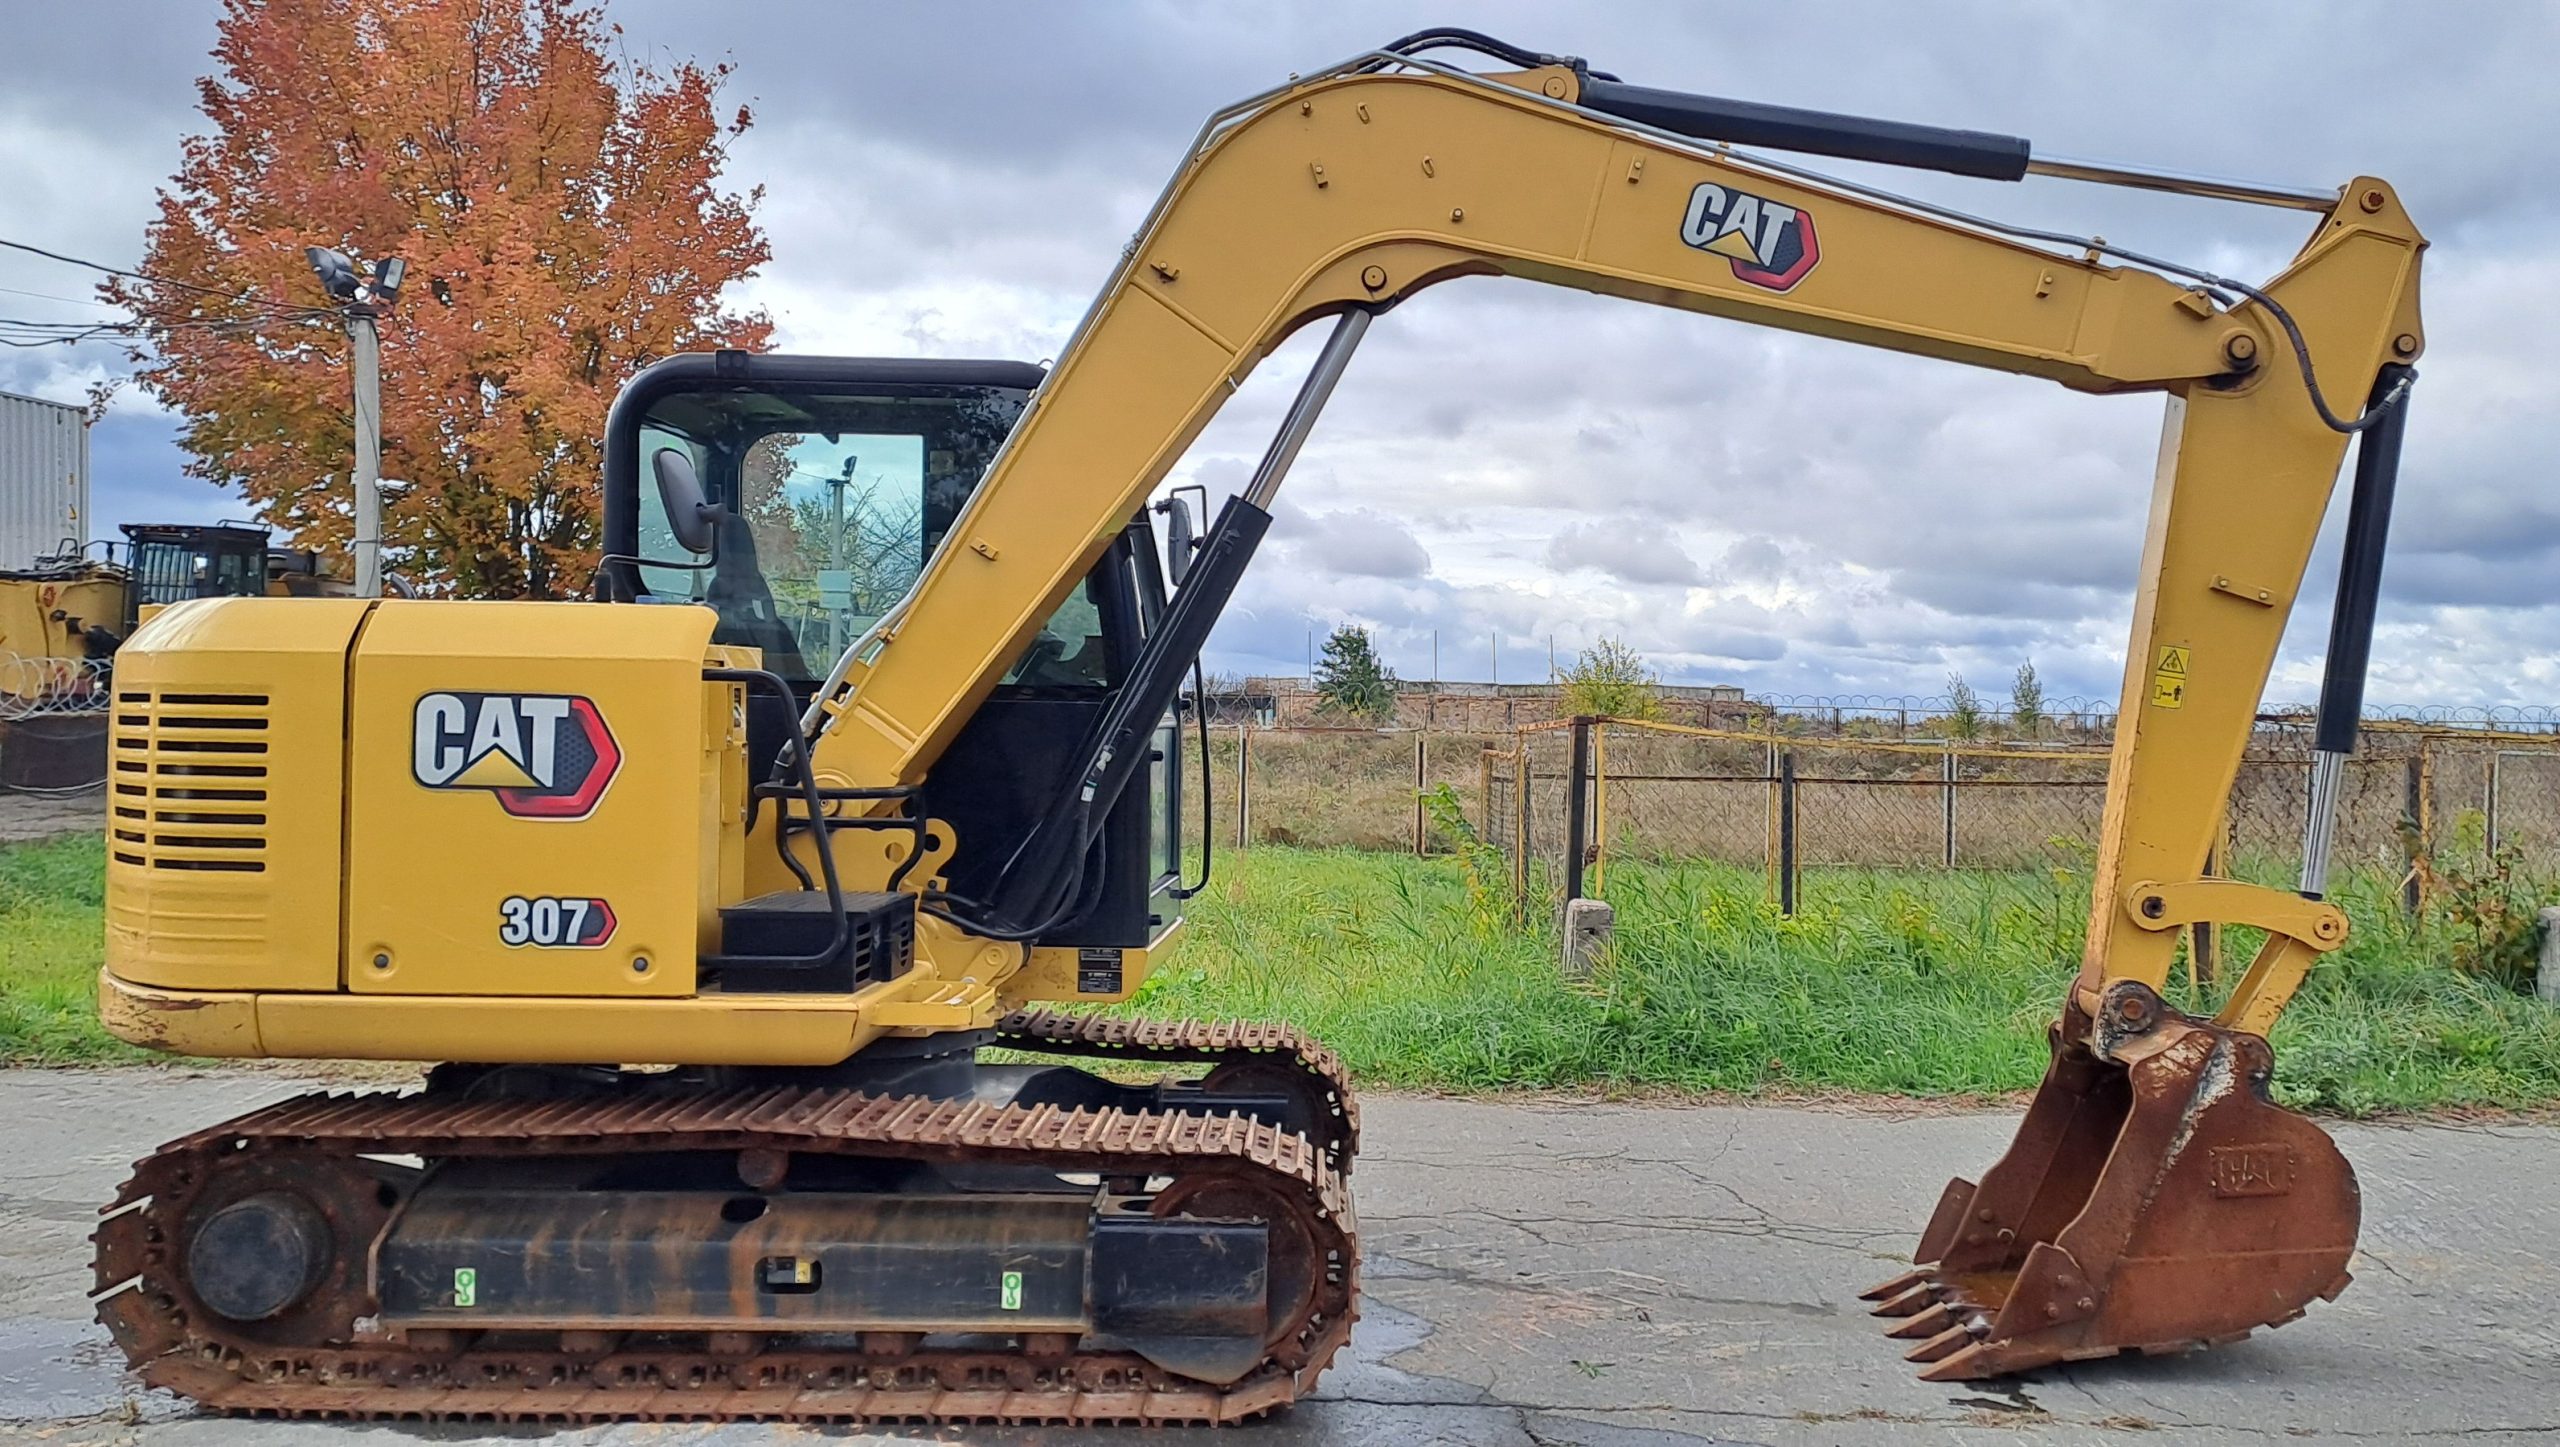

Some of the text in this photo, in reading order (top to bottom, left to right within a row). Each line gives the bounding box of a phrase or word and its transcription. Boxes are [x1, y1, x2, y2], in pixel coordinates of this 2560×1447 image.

[1682, 183, 1796, 267] CAT
[414, 693, 570, 788] CAT
[502, 898, 589, 944] 307
